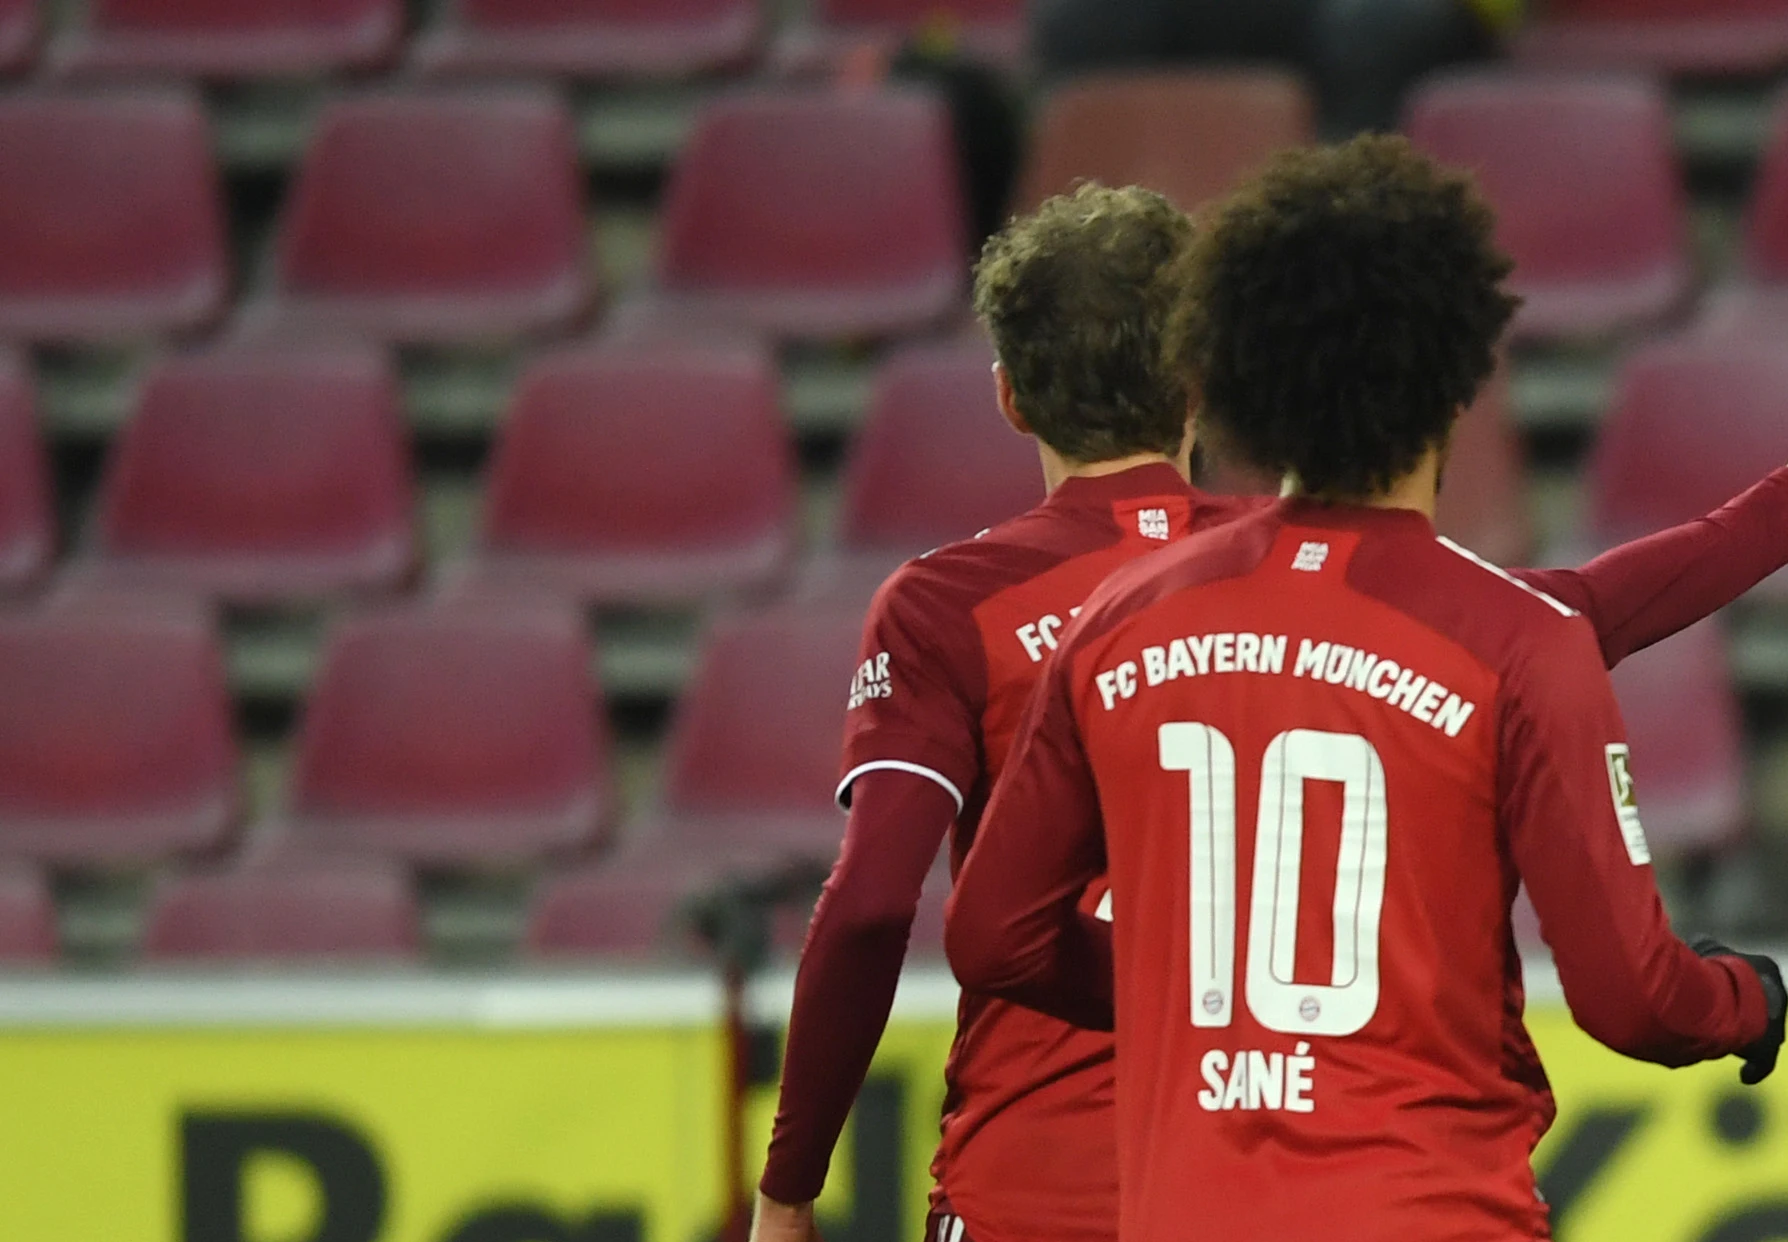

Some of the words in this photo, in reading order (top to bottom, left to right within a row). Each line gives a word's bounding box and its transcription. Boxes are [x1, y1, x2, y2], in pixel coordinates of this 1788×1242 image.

[1015, 613, 1062, 662] FC
[1095, 661, 1138, 711] FC
[1142, 632, 1288, 686] BAYERN
[1157, 722, 1388, 1036] 10
[1198, 1041, 1315, 1113] SANÉ
